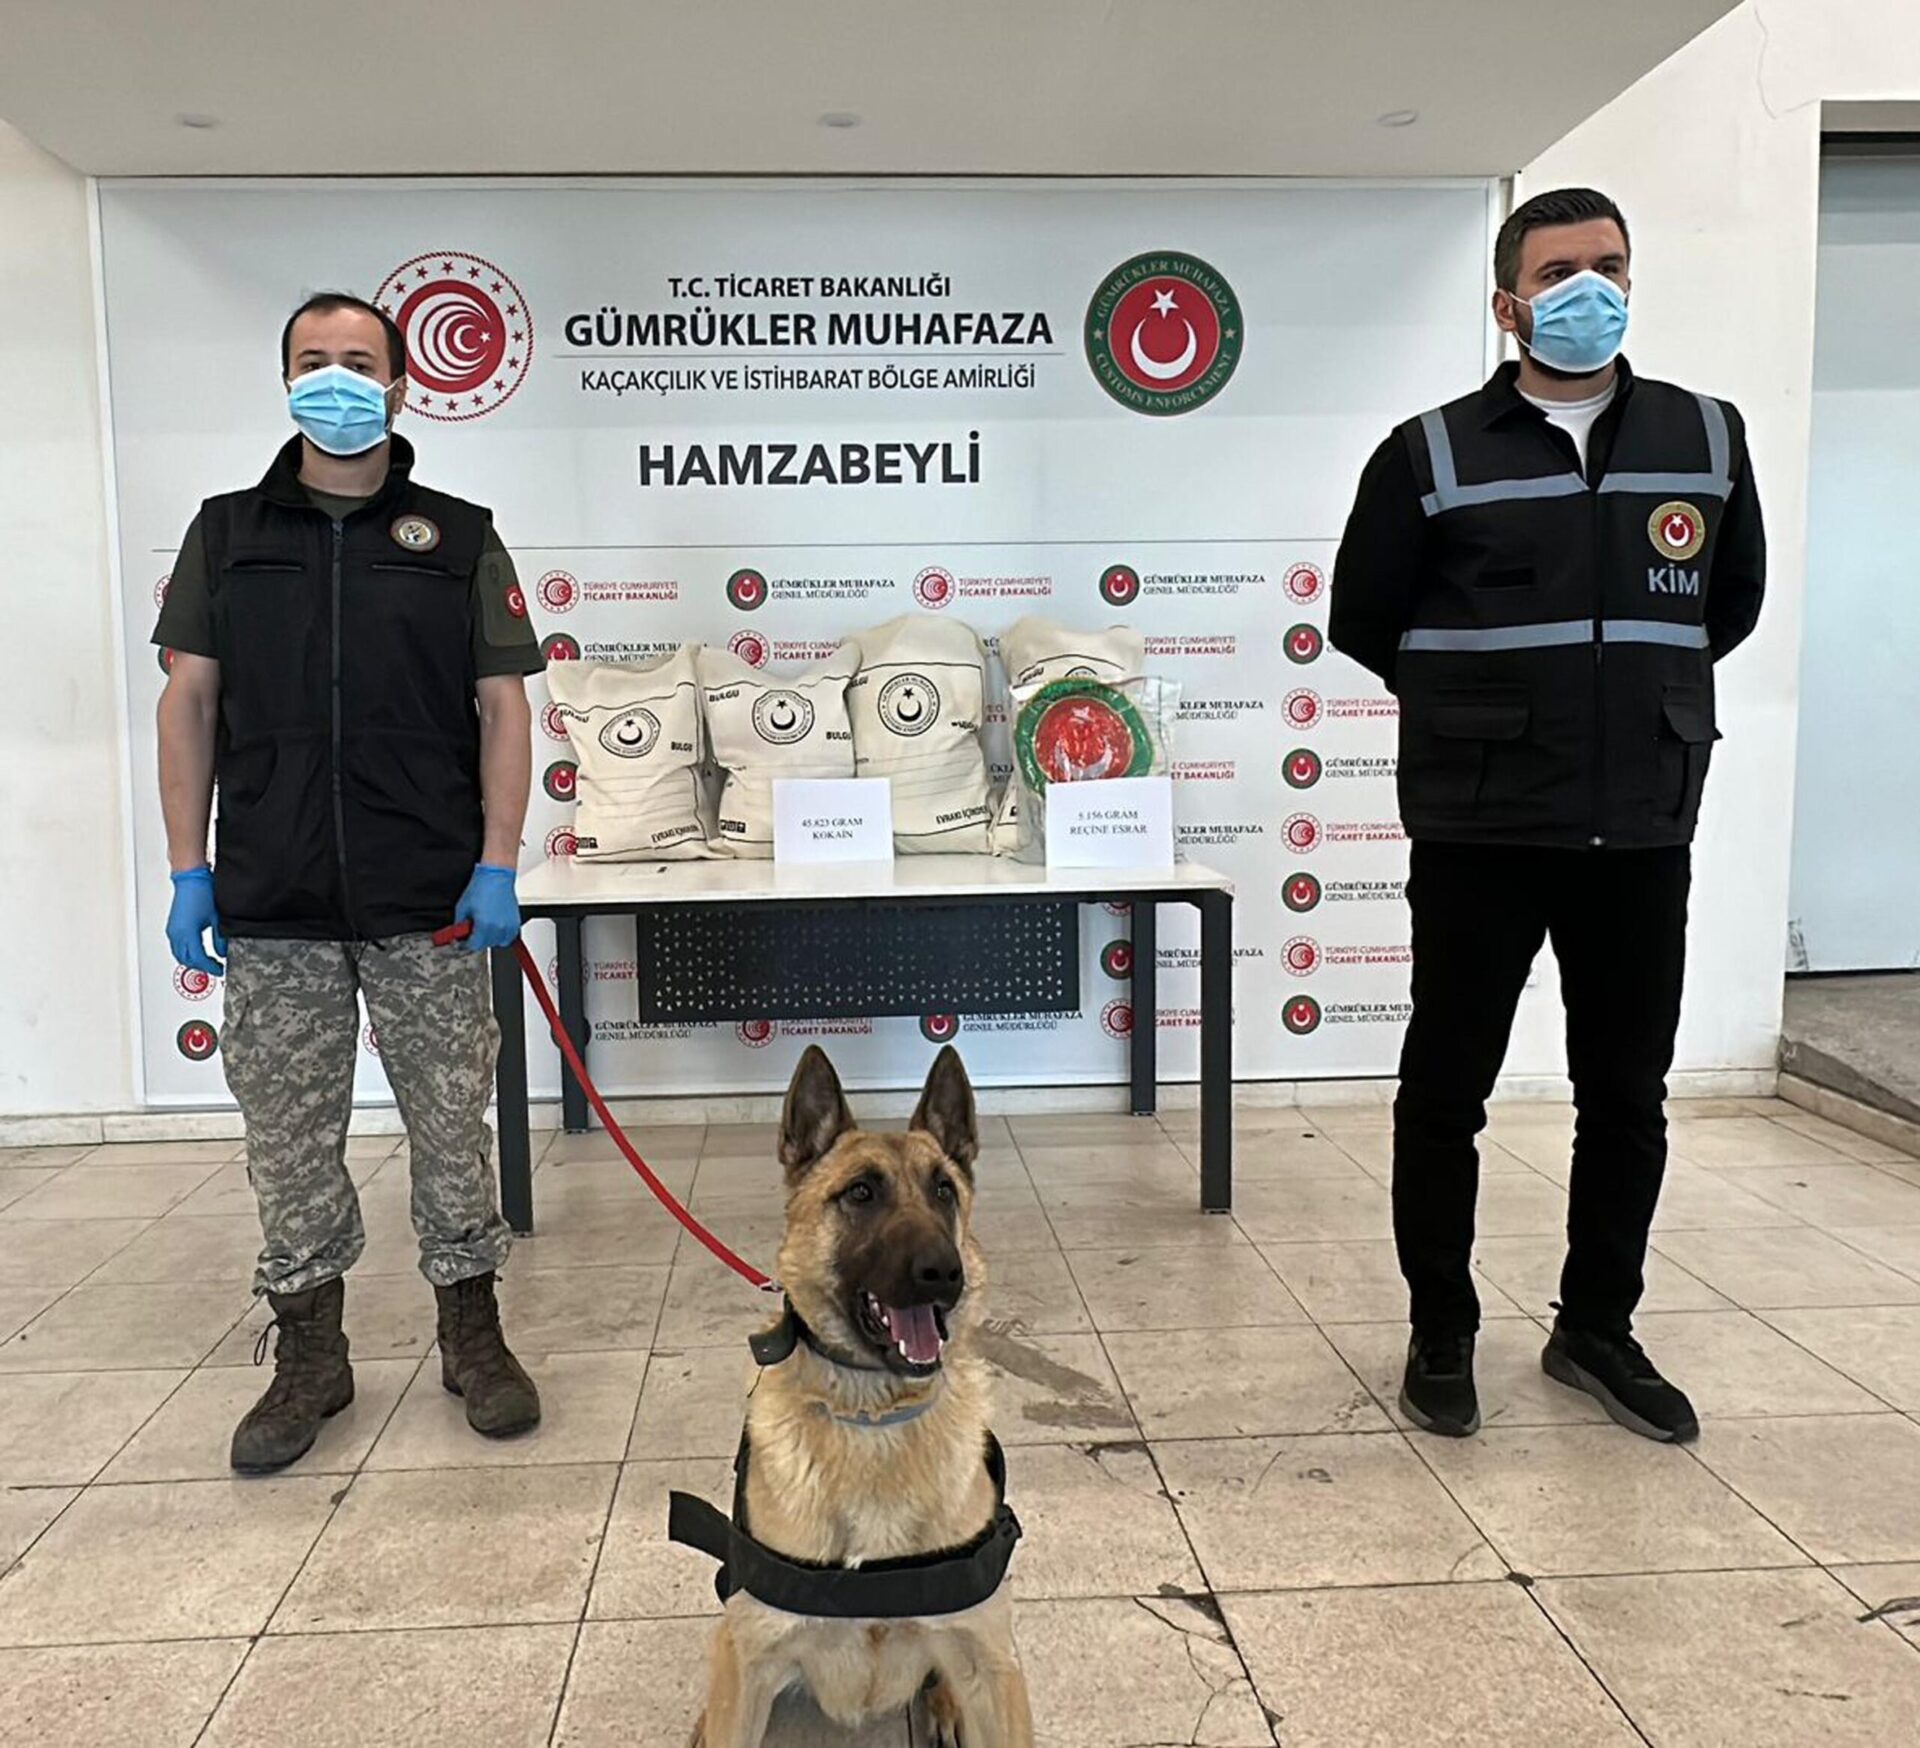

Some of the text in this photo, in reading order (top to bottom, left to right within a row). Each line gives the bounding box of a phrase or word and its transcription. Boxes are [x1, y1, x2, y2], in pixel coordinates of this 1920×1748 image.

[668, 272, 951, 298] T.C. TİCARET BAKANLIĞI
[564, 306, 1054, 346] GÜMRÜKLER MUHAFAZA
[581, 363, 1036, 396] KAÇAKÇILIK VE İSTİHBARAT BÖLGE AMİRLİĞİ
[639, 430, 980, 486] HAMZABEYLİ
[771, 578, 895, 589] GÜMRÜKLER MUHAFAZA
[1143, 574, 1265, 585] GÜMRÜKLER MUHAFAZA
[1647, 563, 1700, 596] KİM
[771, 590, 804, 600] GENEL
[959, 585, 1052, 597] TİCARET BAKANLIĞI
[1143, 585, 1174, 595] GENEL
[583, 590, 679, 601] TİCARET BAKANLIĞI
[773, 650, 812, 660] TİCARET
[1144, 646, 1181, 656] TİCARET
[1209, 700, 1264, 710] MUHAFAZA
[1327, 708, 1399, 717] TİCARET BAKAN
[1104, 810, 1139, 820] GRAM
[832, 817, 863, 827] GRAM
[1209, 824, 1263, 834] MUHAFAZA
[1325, 832, 1363, 841] TİCARET
[1232, 948, 1264, 958] AFAZA
[1325, 953, 1411, 965] TİCARET BAKANLIĞ
[594, 971, 633, 981] TİCARET
[782, 1027, 819, 1036] TİCARET
